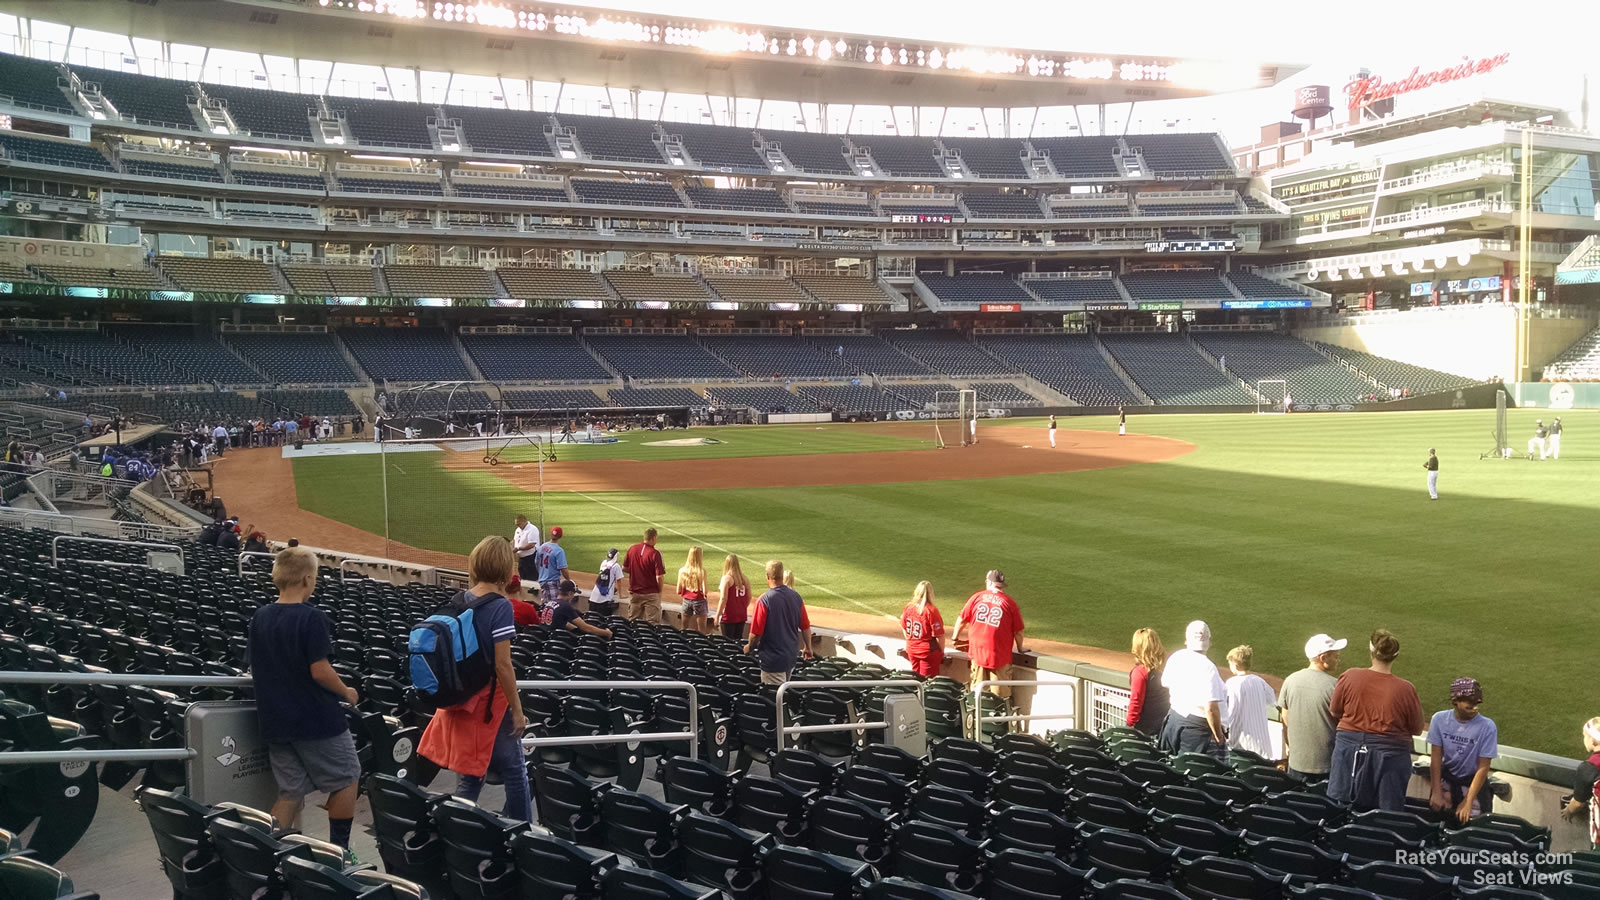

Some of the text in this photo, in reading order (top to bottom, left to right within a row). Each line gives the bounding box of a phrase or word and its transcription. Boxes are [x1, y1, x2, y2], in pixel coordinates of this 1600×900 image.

[1343, 52, 1509, 110] Budweiser
[1300, 87, 1318, 99] Ford
[1299, 181, 1330, 194] BEAUTIFUL
[1330, 178, 1341, 189] DAY
[1351, 169, 1380, 184] BASEBALL
[16, 200, 33, 214] go
[1320, 210, 1341, 222] TWINS
[41, 244, 96, 257] FIELD
[128, 463, 138, 471] 24
[540, 553, 549, 568] 14
[976, 603, 1003, 627] 22
[1442, 732, 1469, 743] TWINS
[233, 767, 260, 779] PLAYING
